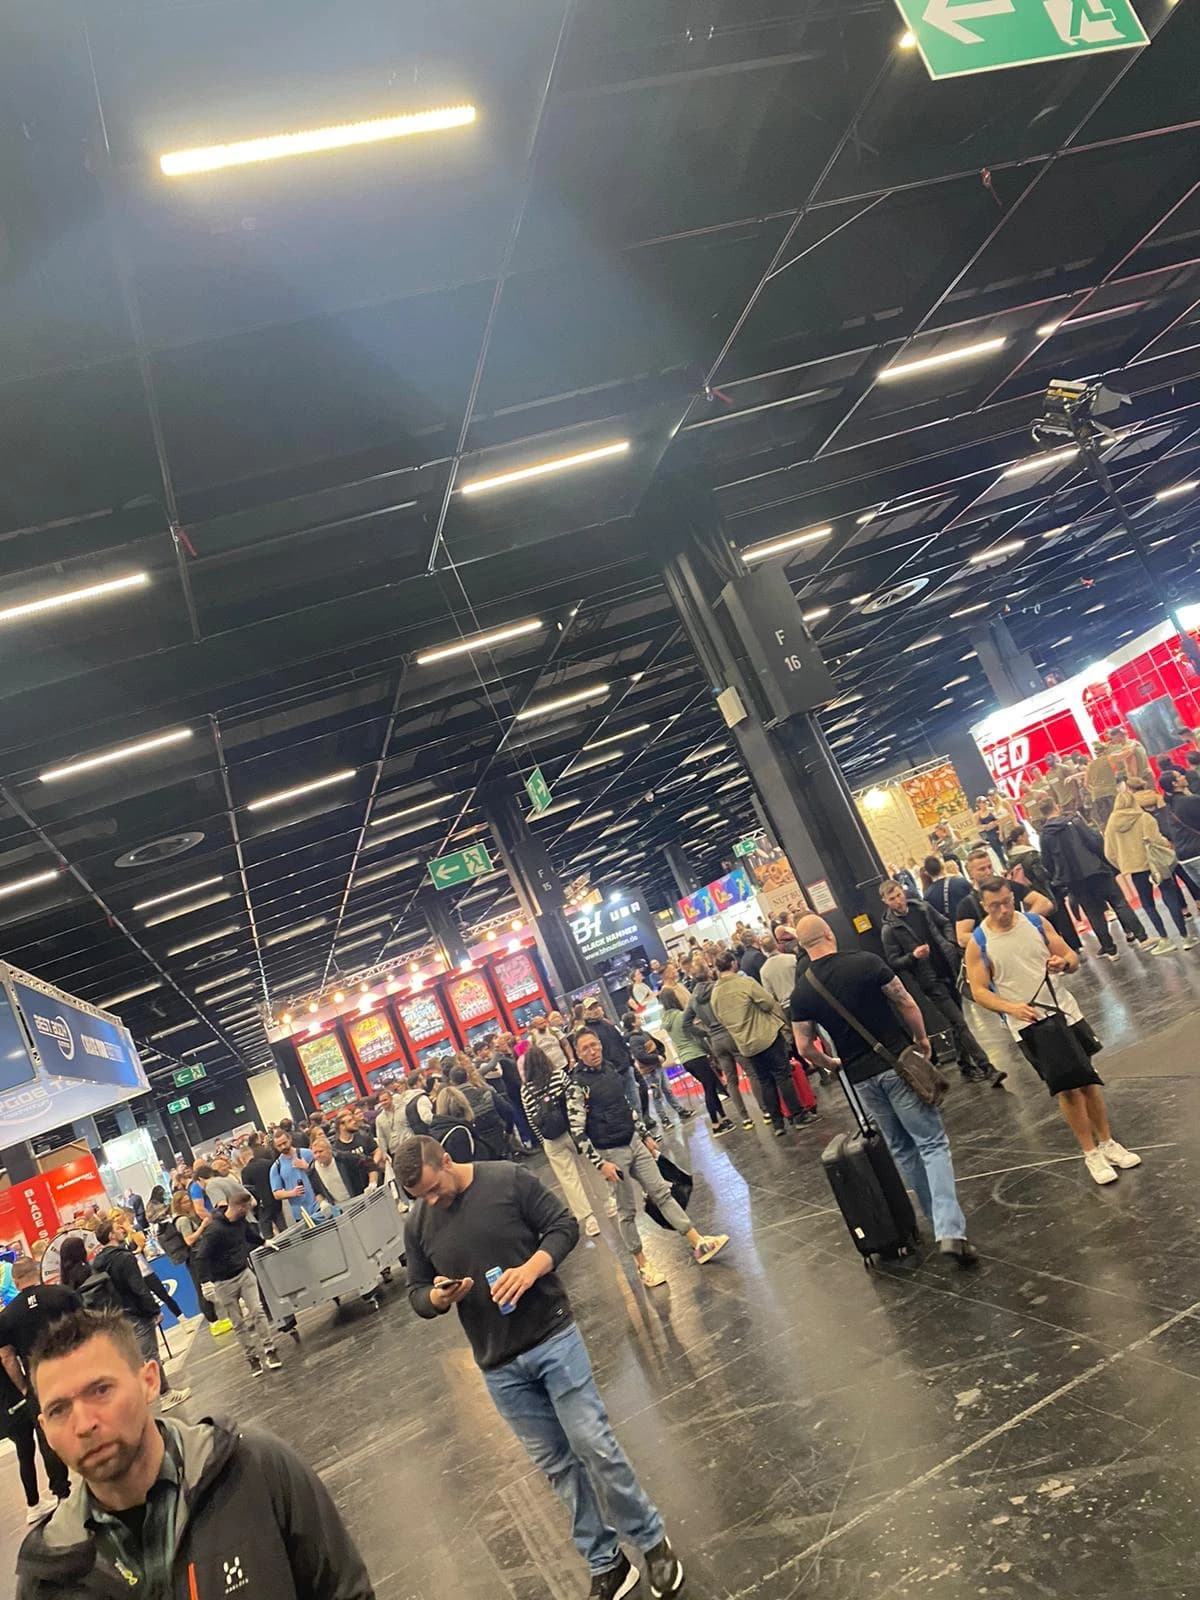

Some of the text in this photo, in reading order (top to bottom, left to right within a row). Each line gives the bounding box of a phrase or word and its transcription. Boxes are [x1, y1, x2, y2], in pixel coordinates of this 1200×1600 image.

[775, 629, 785, 646] F
[784, 654, 802, 672] 16
[537, 869, 544, 878] F
[542, 881, 552, 892] 15
[581, 924, 639, 953] BLACK HAMMER
